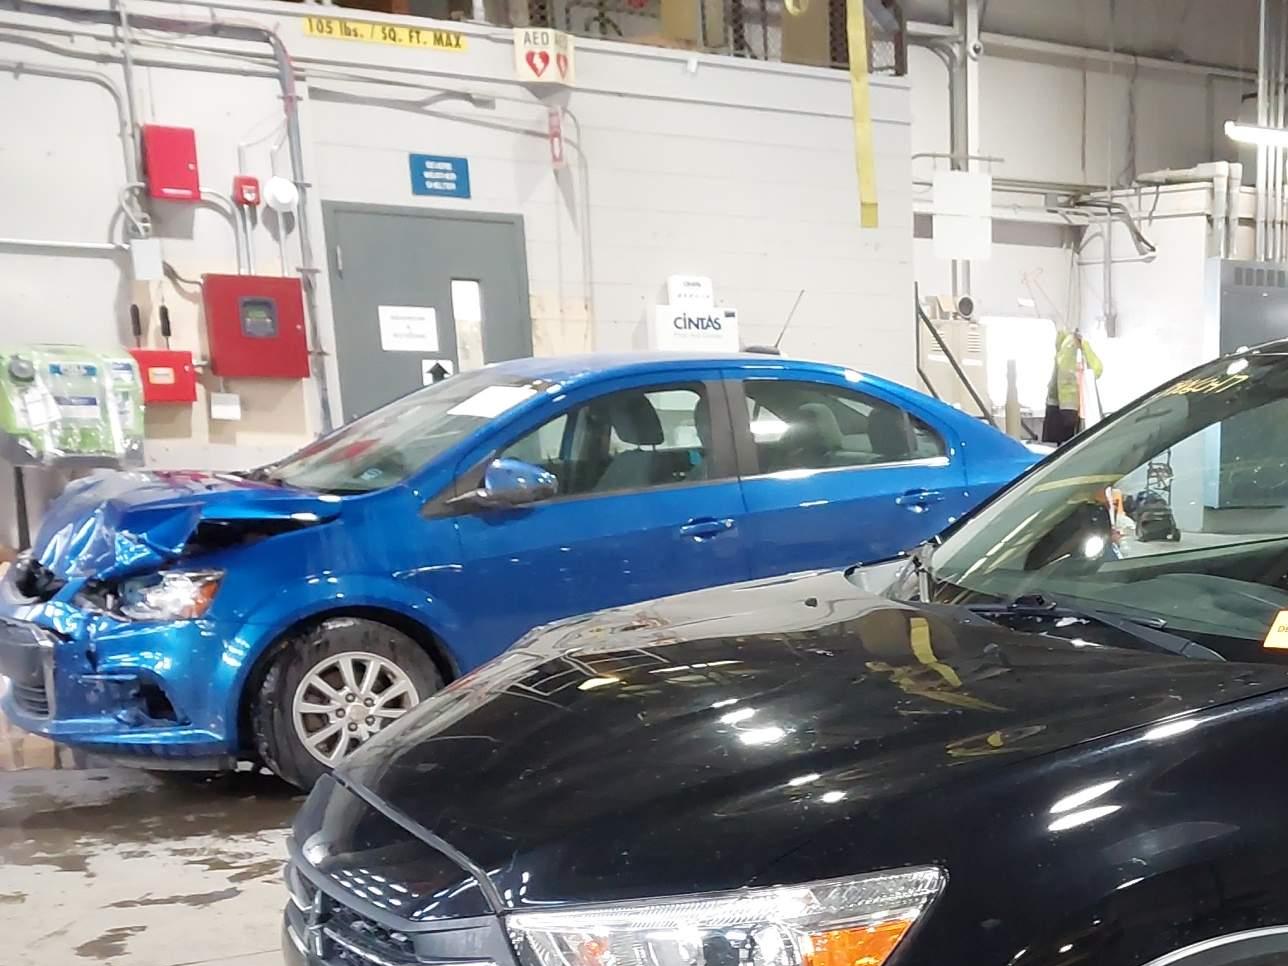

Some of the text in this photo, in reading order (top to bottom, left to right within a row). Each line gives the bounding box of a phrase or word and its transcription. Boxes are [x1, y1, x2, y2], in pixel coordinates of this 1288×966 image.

[307, 17, 333, 35] 105
[339, 19, 364, 38] lbs.
[381, 24, 402, 43] SQ.
[408, 29, 427, 45] FT.
[433, 31, 462, 49] MAX
[523, 31, 550, 46] AED
